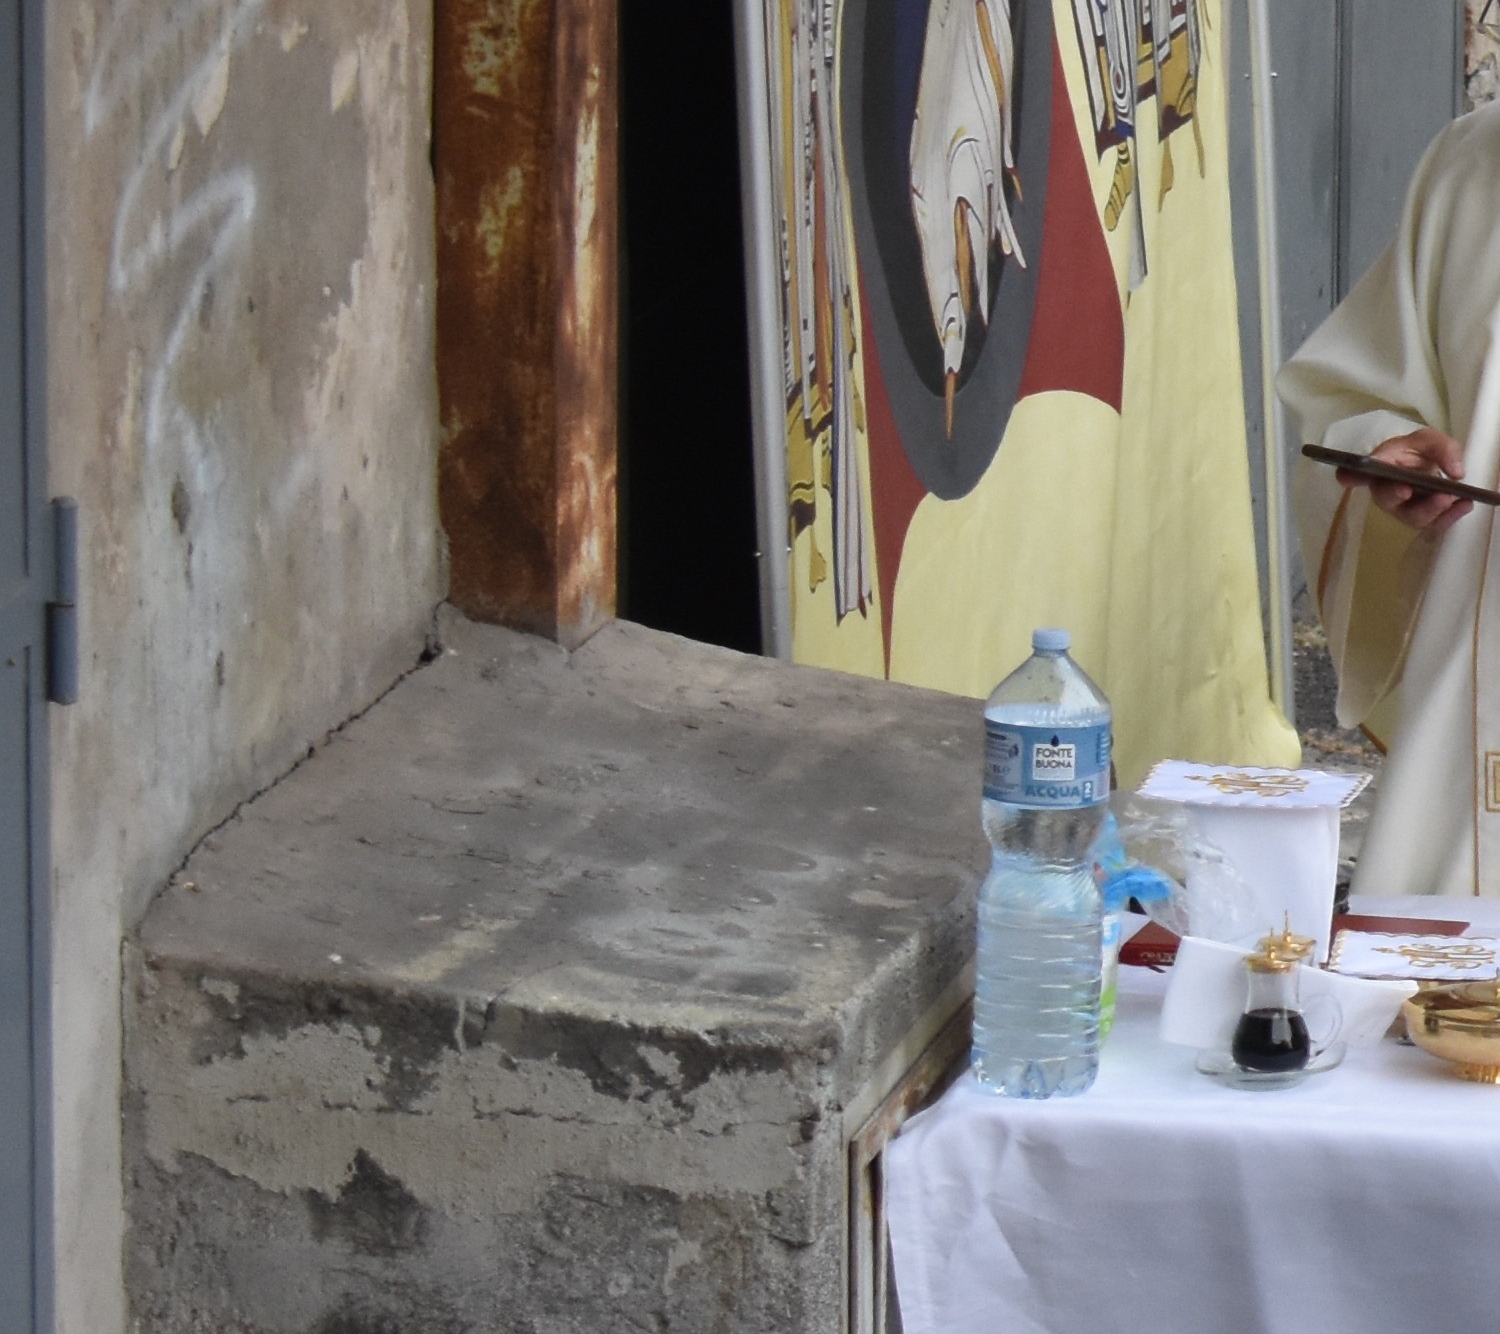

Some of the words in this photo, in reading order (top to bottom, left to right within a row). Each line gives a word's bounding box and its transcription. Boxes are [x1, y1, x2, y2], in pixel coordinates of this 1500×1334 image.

[1035, 747, 1073, 759] FONTE
[1035, 760, 1072, 769] BUONA
[1024, 784, 1080, 799] ACQUA
